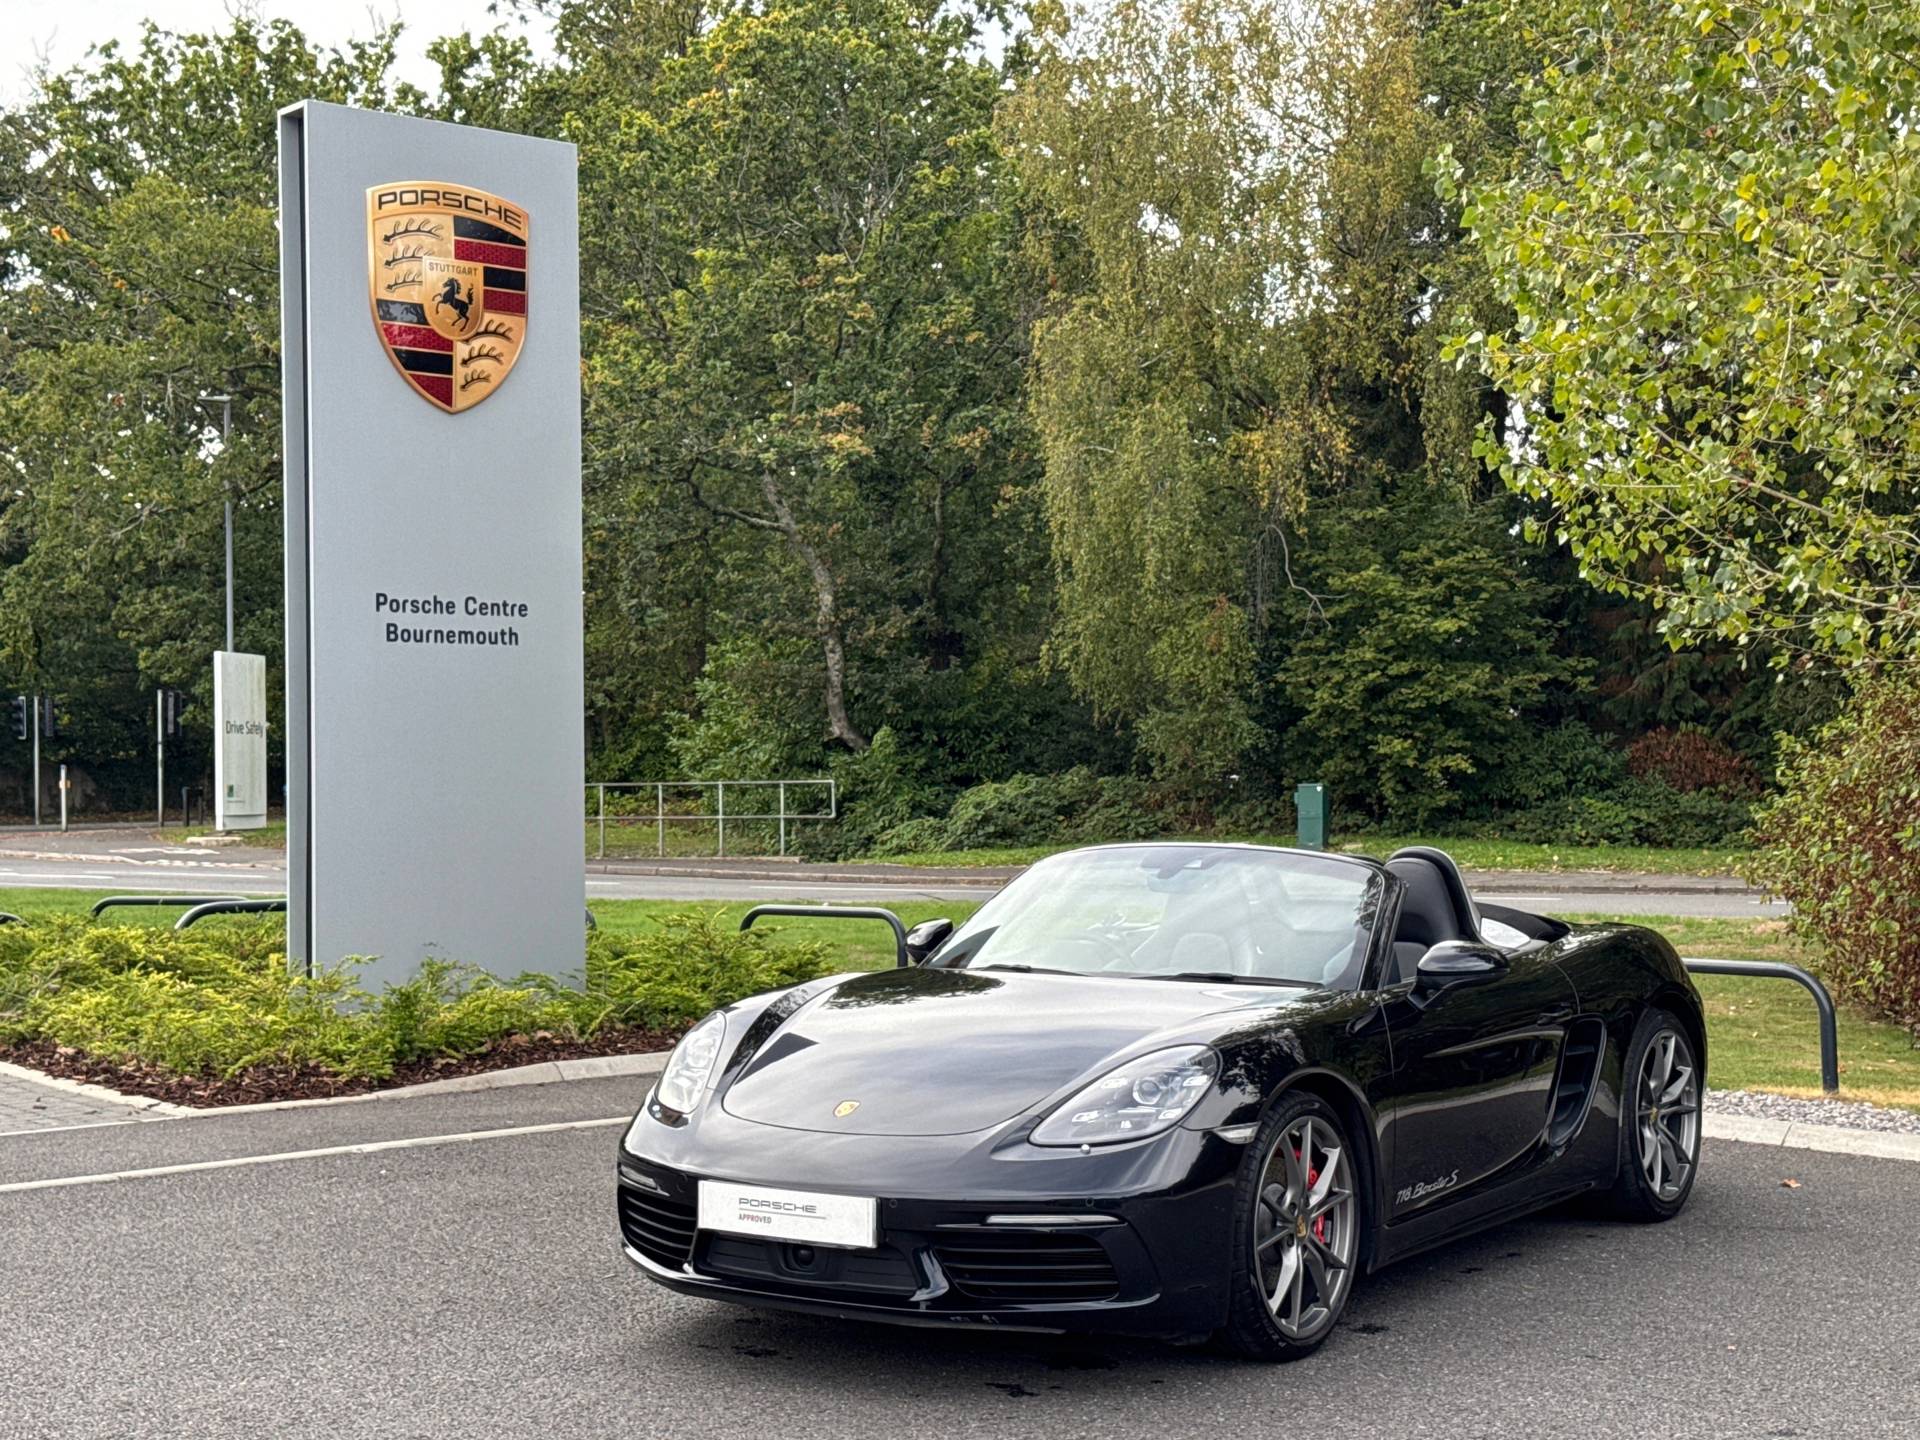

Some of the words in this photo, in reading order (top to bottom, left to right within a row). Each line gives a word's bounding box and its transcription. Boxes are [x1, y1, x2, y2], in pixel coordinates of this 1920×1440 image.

[378, 189, 522, 230] PORSCHE
[428, 261, 478, 277] STUTTGART
[375, 592, 456, 615] Porsche
[464, 596, 529, 618] Centre
[386, 622, 519, 646] Bournemouth
[225, 720, 244, 735] Drive
[245, 721, 264, 738] Safely
[1395, 1185, 1412, 1205] 718
[1446, 1169, 1459, 1187] S
[738, 1197, 817, 1214] PORSCHE
[738, 1213, 772, 1224] APPROVED
